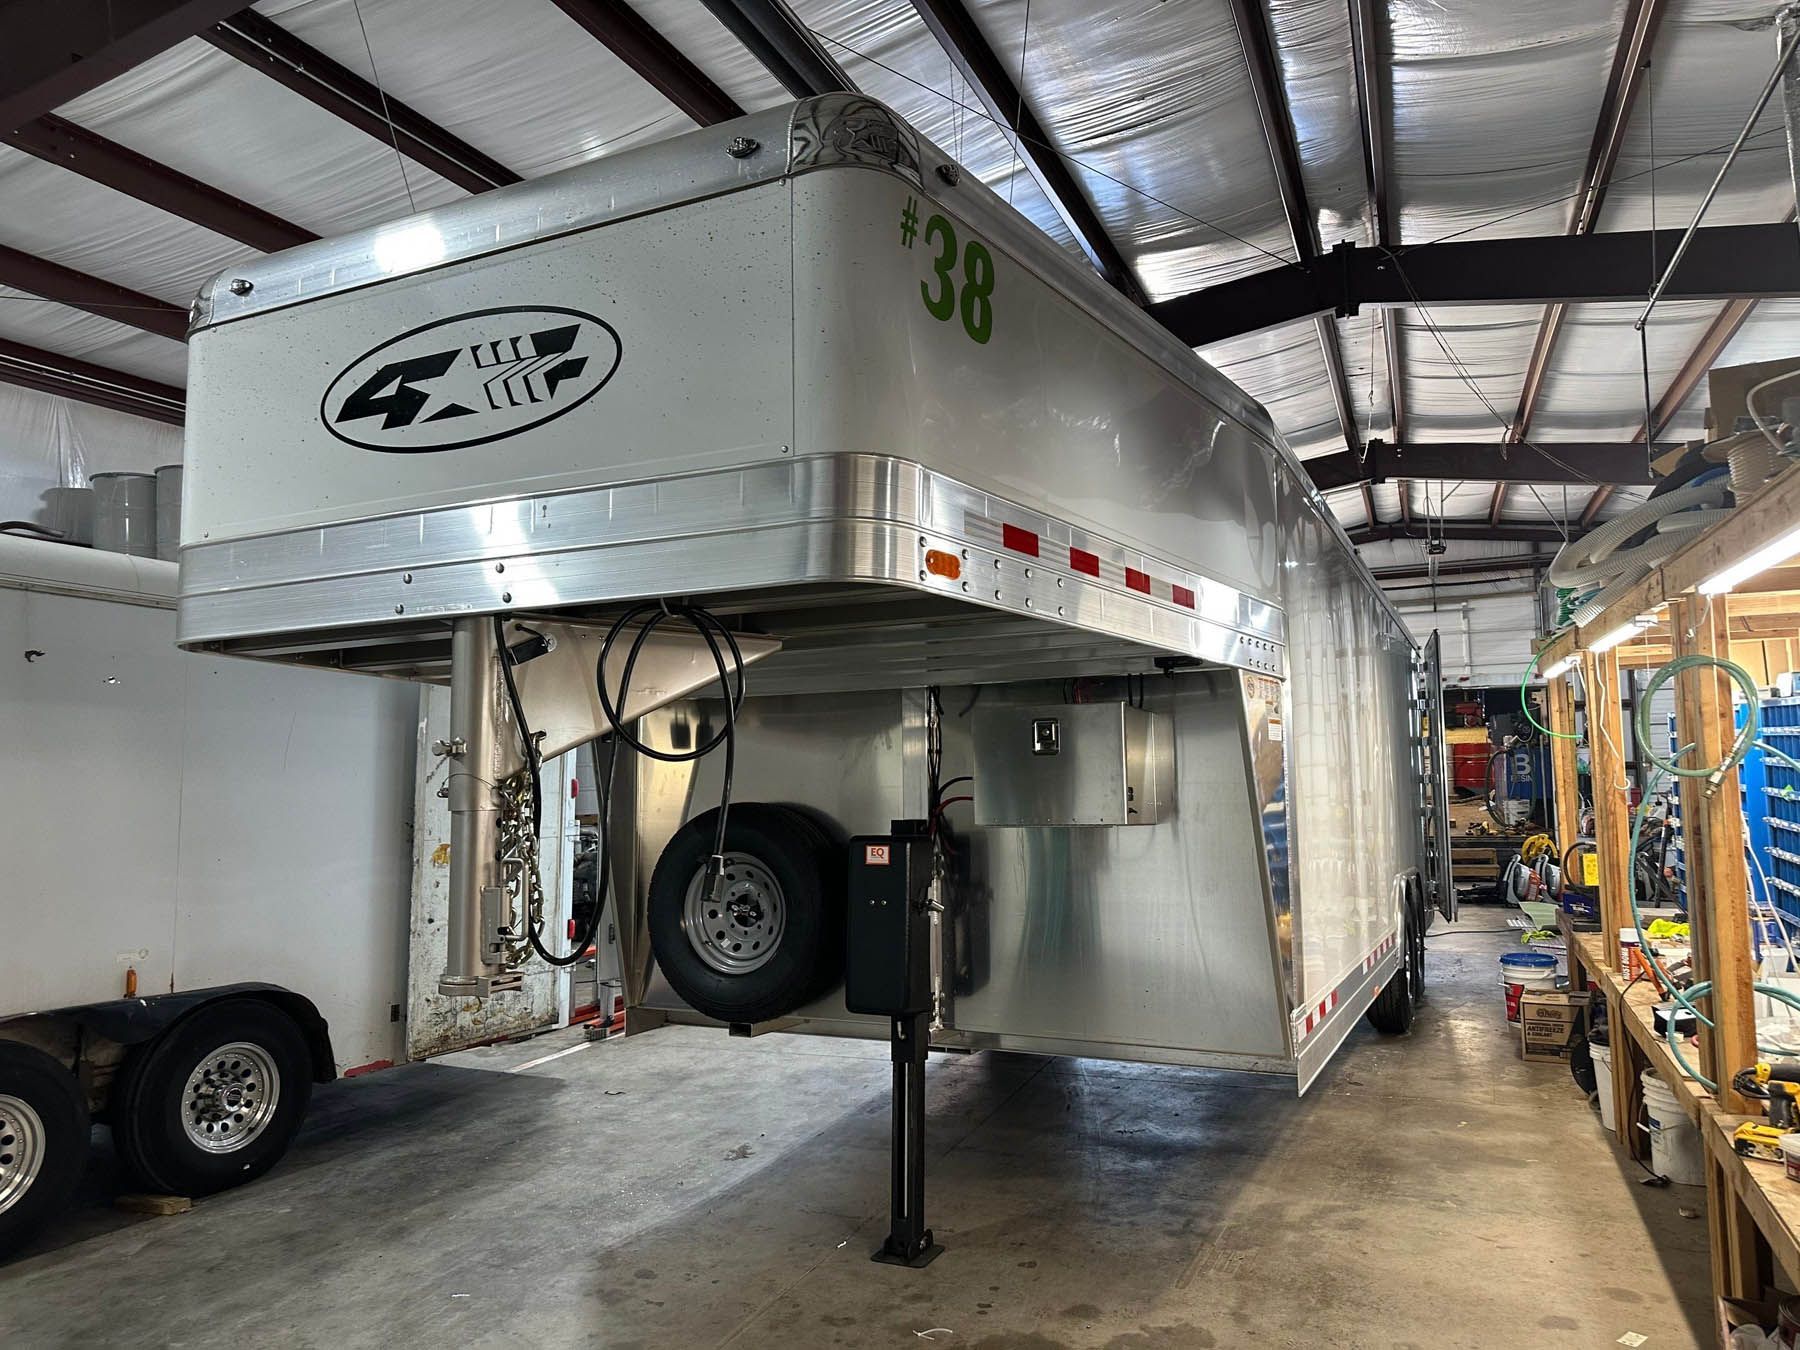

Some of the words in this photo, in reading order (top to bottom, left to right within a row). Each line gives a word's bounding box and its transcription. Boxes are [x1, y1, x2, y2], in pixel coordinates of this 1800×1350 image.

[901, 196, 994, 344] #38
[1513, 753, 1531, 775] B
[870, 847, 884, 859] EQ
[1527, 1025, 1564, 1034] ANTIFREEZE
